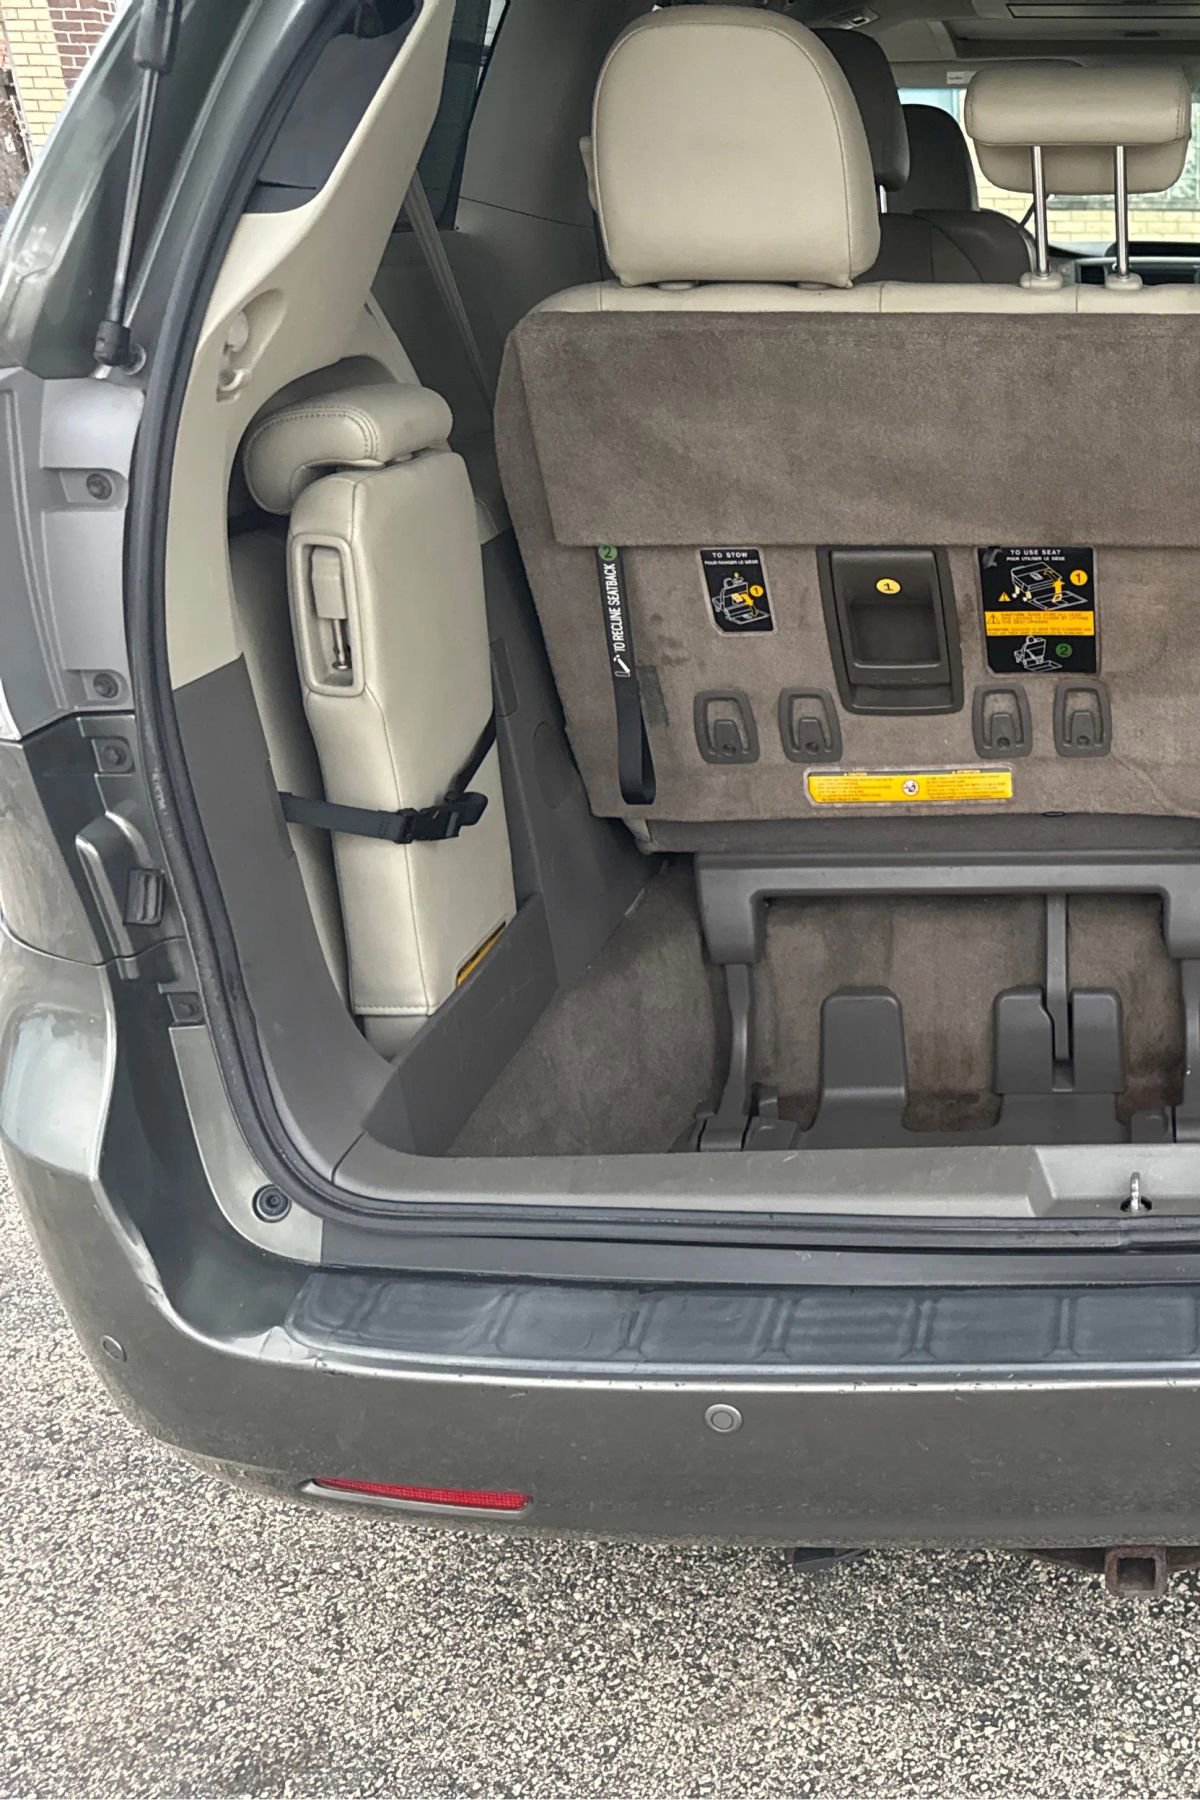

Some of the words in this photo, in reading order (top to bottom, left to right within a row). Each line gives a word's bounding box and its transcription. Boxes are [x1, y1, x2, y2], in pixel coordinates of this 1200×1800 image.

[603, 563, 620, 606] SEATBACK
[608, 607, 625, 641] RECLINE
[613, 642, 626, 653] TO
